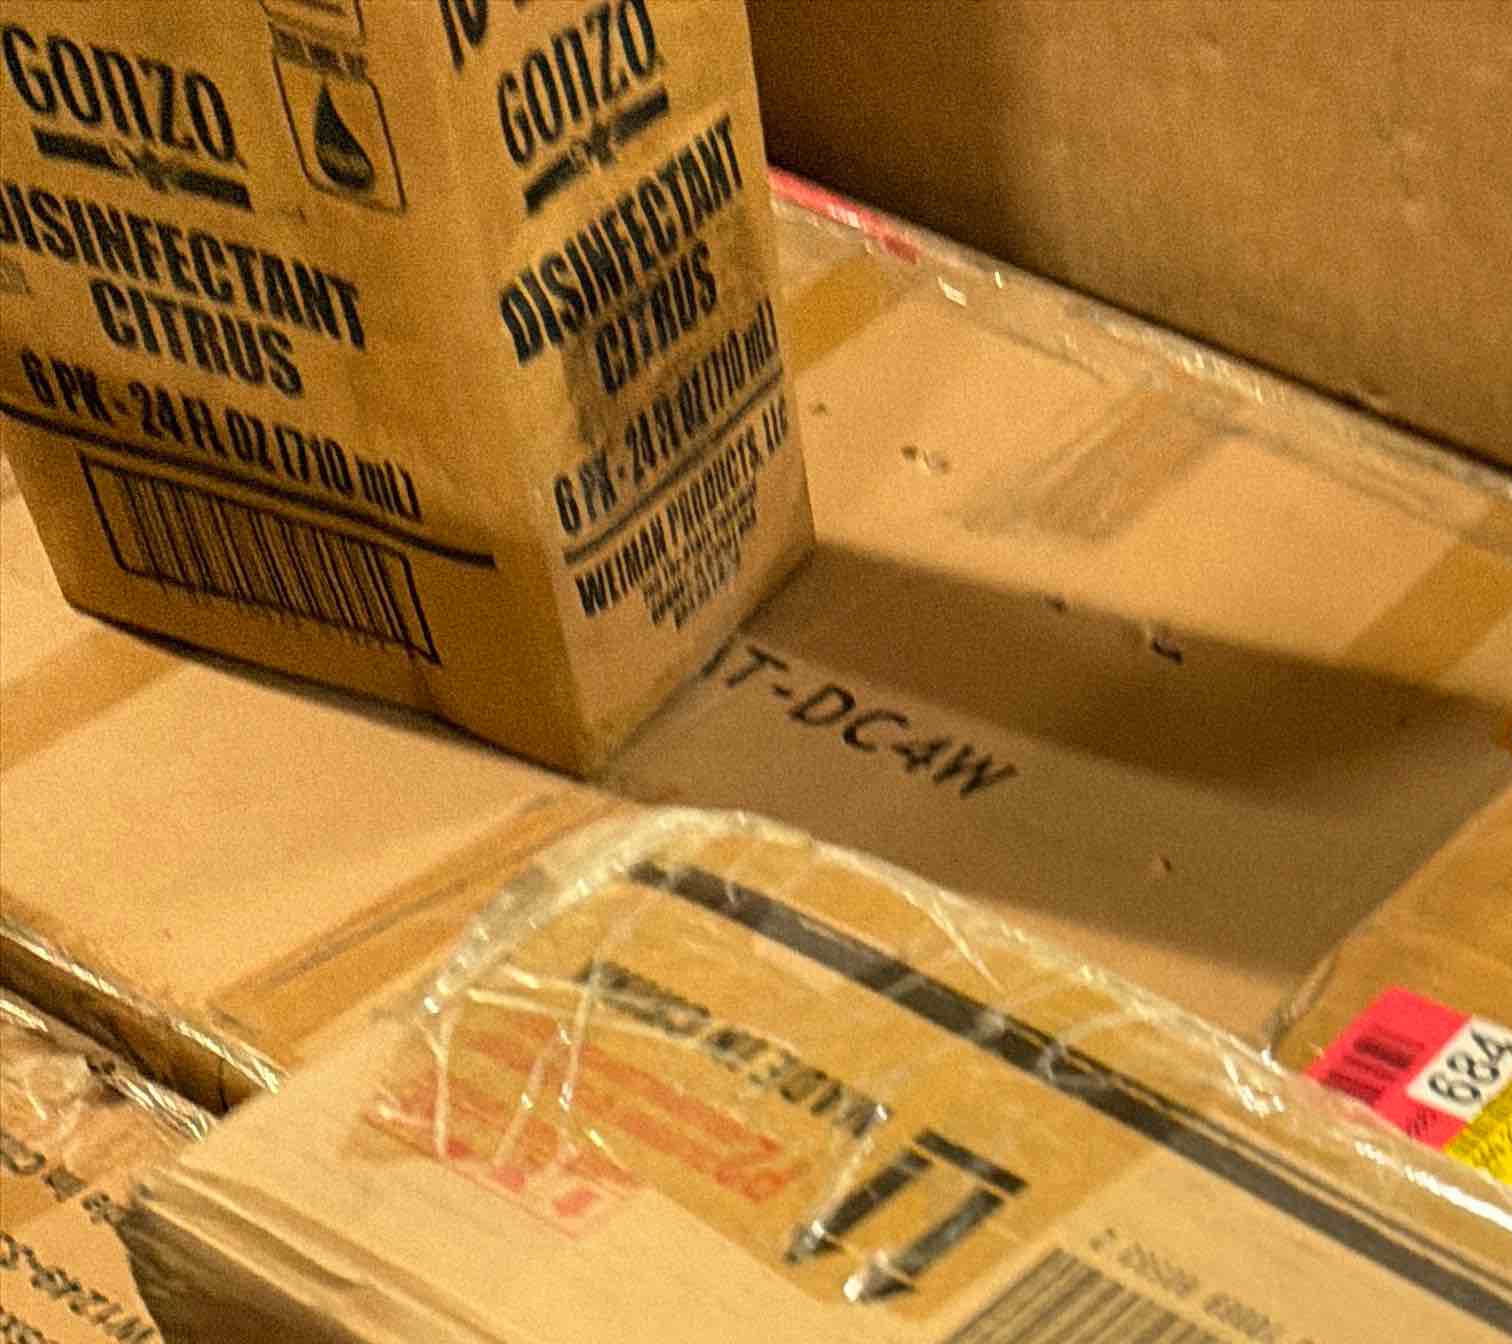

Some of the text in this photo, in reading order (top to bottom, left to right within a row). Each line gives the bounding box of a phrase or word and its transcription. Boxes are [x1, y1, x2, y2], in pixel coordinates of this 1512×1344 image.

[501, 112, 743, 366] DISINFECTANT
[89, 277, 302, 395] CITRUS
[595, 240, 717, 395] CITRUS
[51, 354, 114, 426] PK
[128, 380, 185, 444] 24
